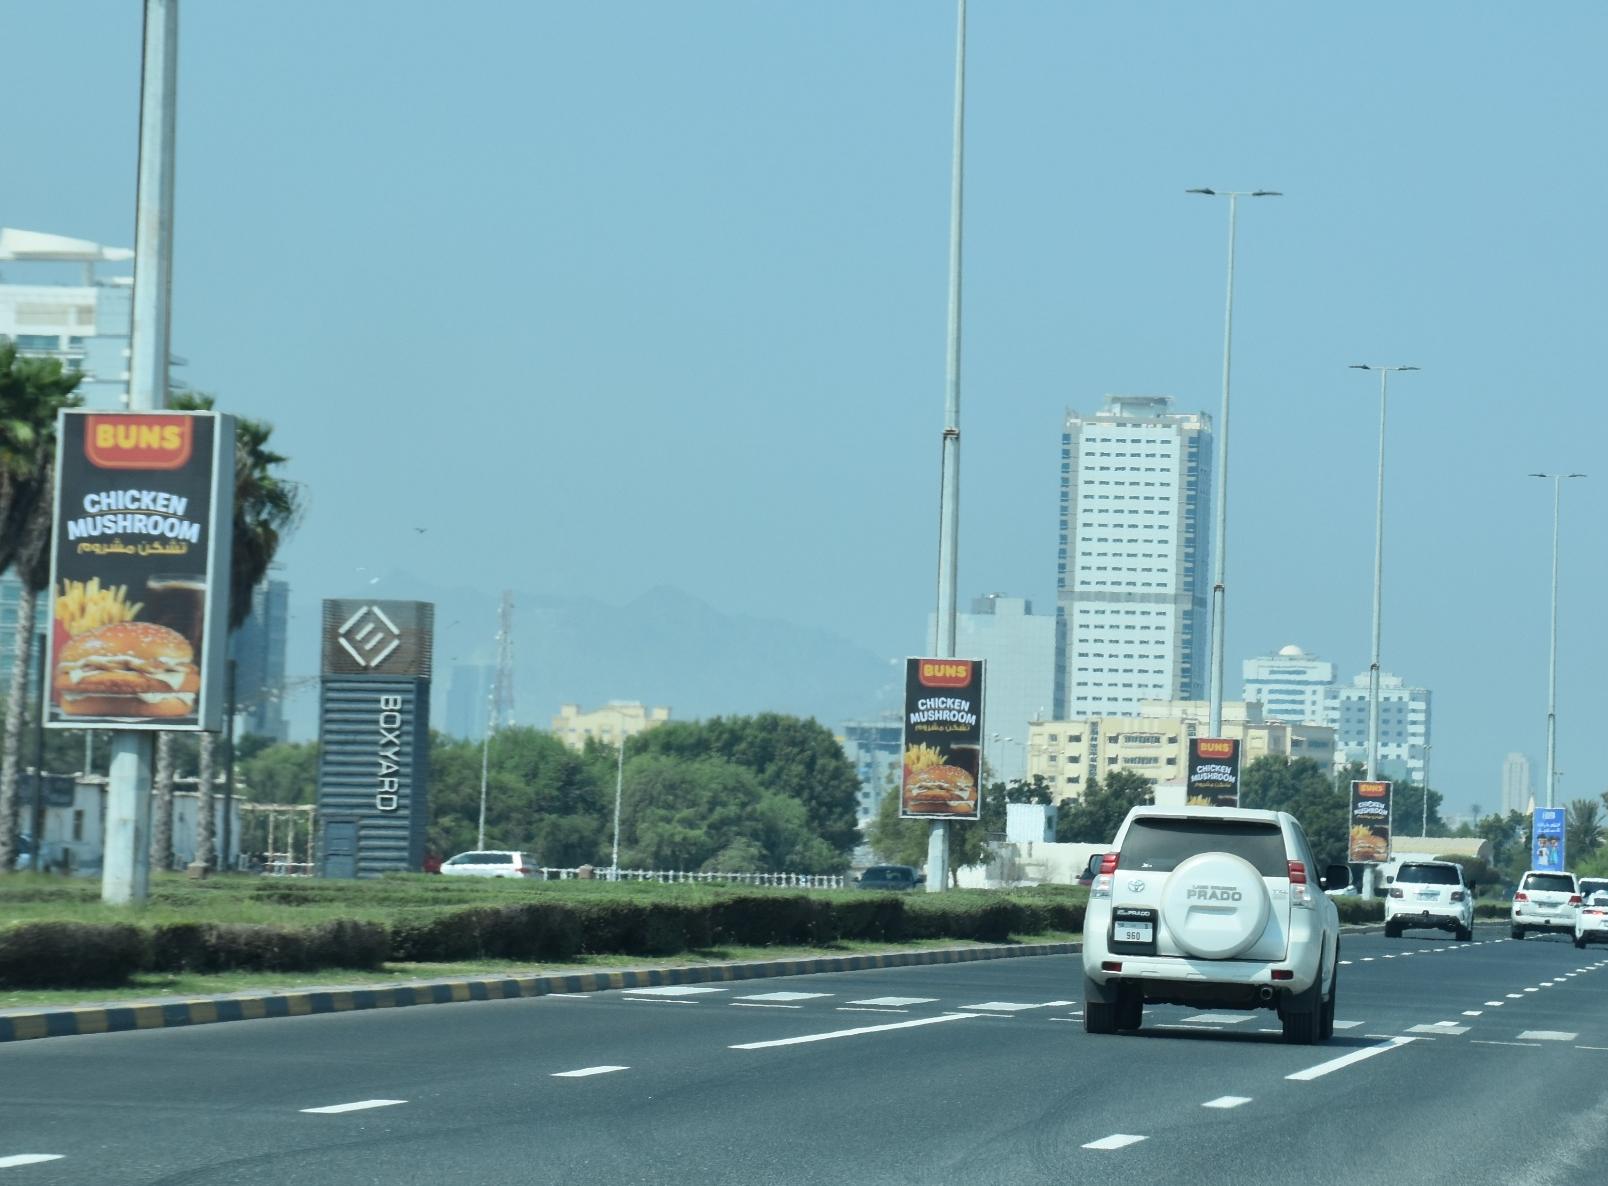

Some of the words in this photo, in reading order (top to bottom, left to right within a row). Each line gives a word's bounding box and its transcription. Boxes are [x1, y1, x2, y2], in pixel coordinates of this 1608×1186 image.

[95, 424, 182, 449] BUNS
[83, 489, 188, 516] CHICKEN
[67, 513, 200, 543] MUSHROOM
[923, 664, 967, 677] BUNS
[918, 697, 970, 712] CHICKEN
[910, 709, 976, 726] MUSHROOM
[376, 695, 401, 811] BOXYARD
[1196, 764, 1232, 774] CHICKEN
[1191, 772, 1236, 784] MUSHROOM
[1186, 888, 1242, 901] PRADO
